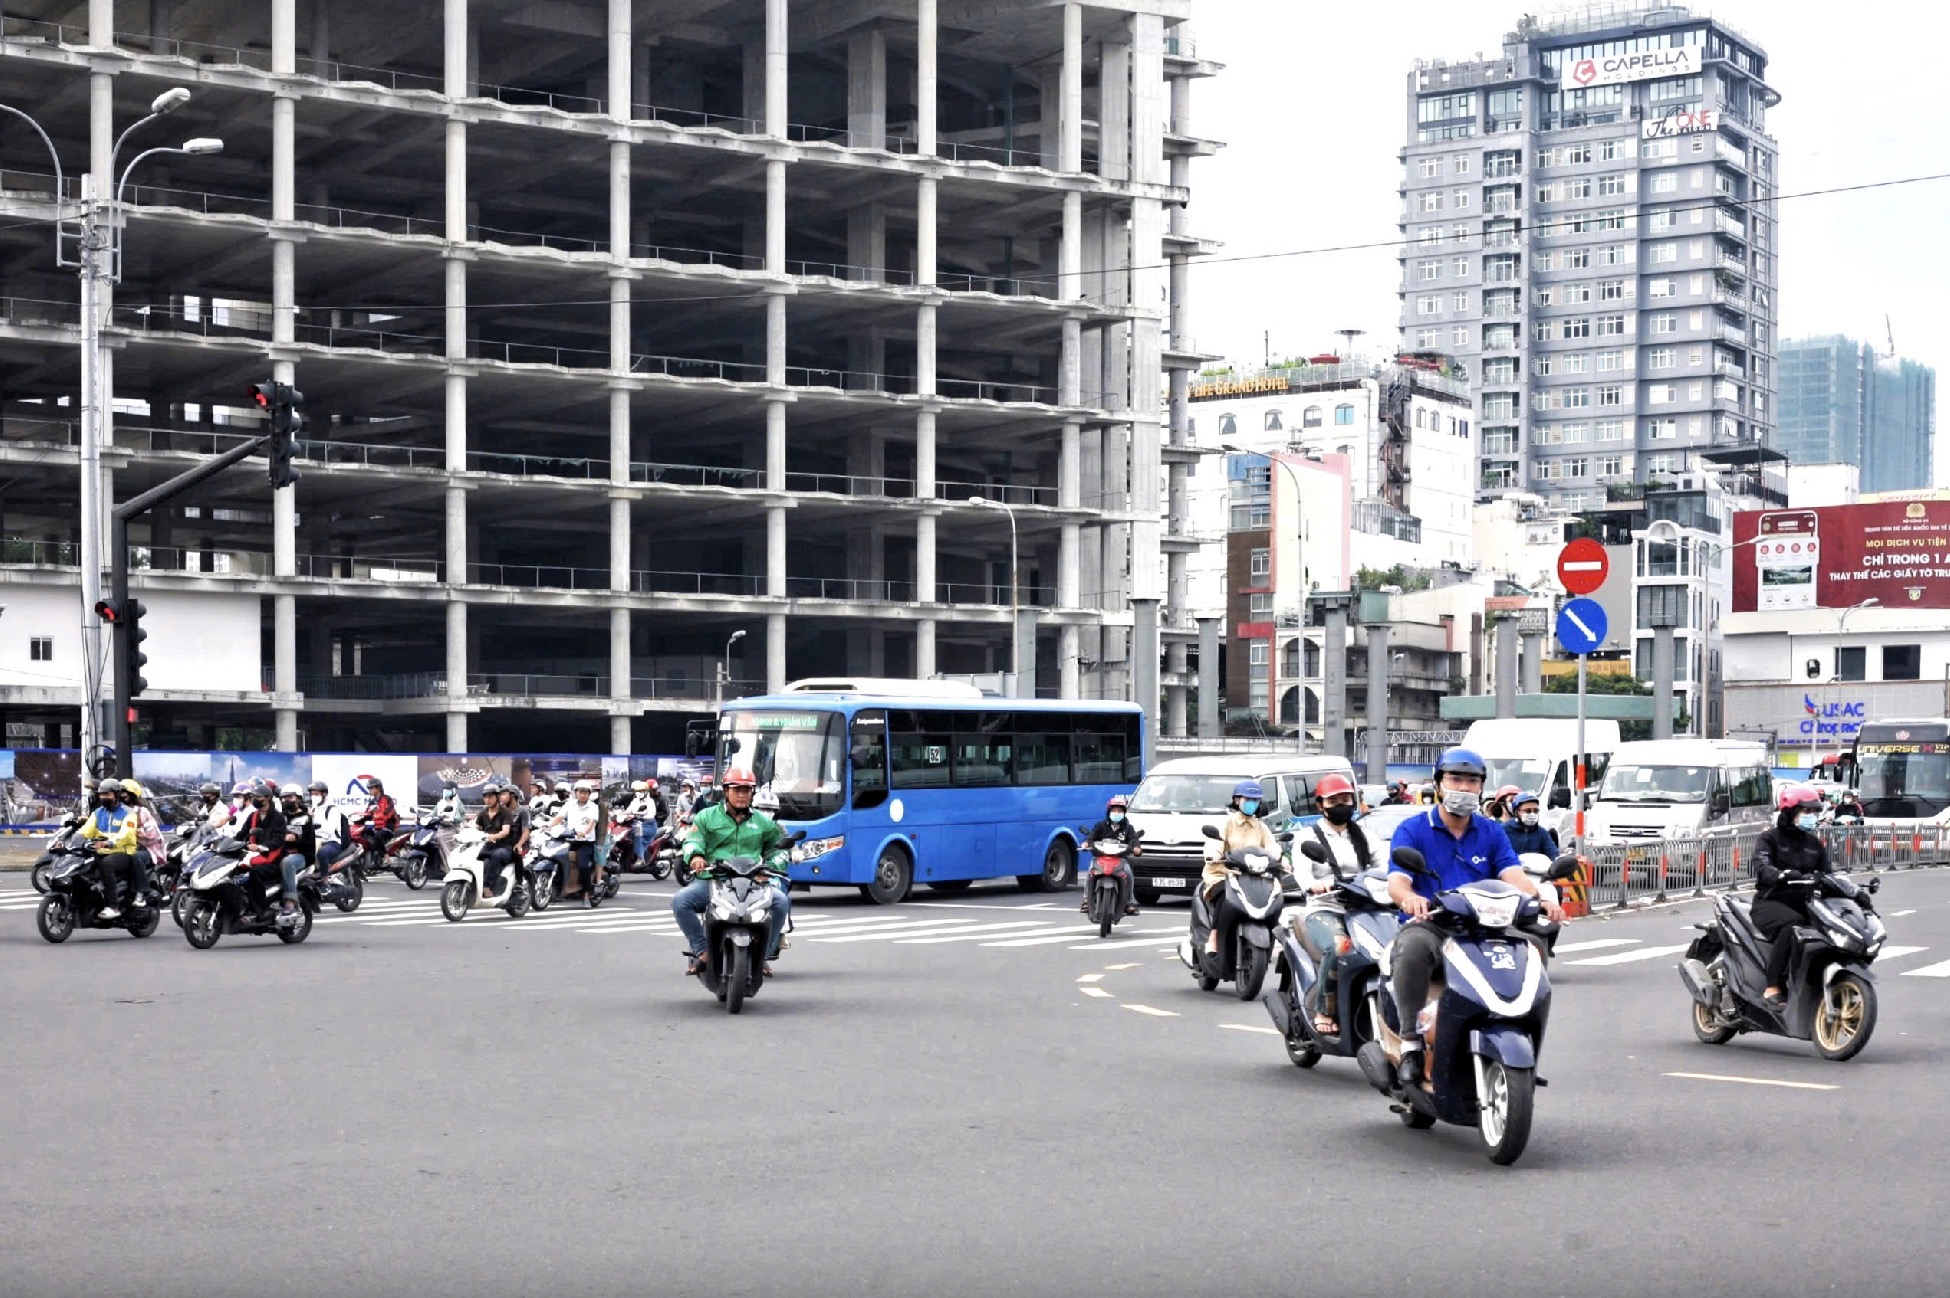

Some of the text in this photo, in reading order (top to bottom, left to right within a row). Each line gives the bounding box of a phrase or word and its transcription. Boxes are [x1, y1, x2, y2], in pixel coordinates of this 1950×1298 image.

[1603, 50, 1688, 72] CAPELLA
[1603, 64, 1690, 81] HOLDINGS
[1676, 110, 1712, 128] ONE
[1215, 381, 1253, 395] GRAND
[1256, 377, 1288, 391] HOTEL
[1865, 539, 1884, 549] MỌI
[1886, 539, 1910, 548] DỊCH
[1862, 553, 1884, 567] CHỈ
[1886, 553, 1930, 565] TRONG
[1934, 553, 1940, 564] 1
[1829, 571, 1851, 581] THAY
[1870, 568, 1891, 579] CÁC
[1823, 702, 1865, 718] USAC
[930, 748, 940, 762] 52
[1857, 745, 1920, 754] UNIVERSE
[1922, 743, 1934, 753] X
[333, 797, 362, 806] HCMC
